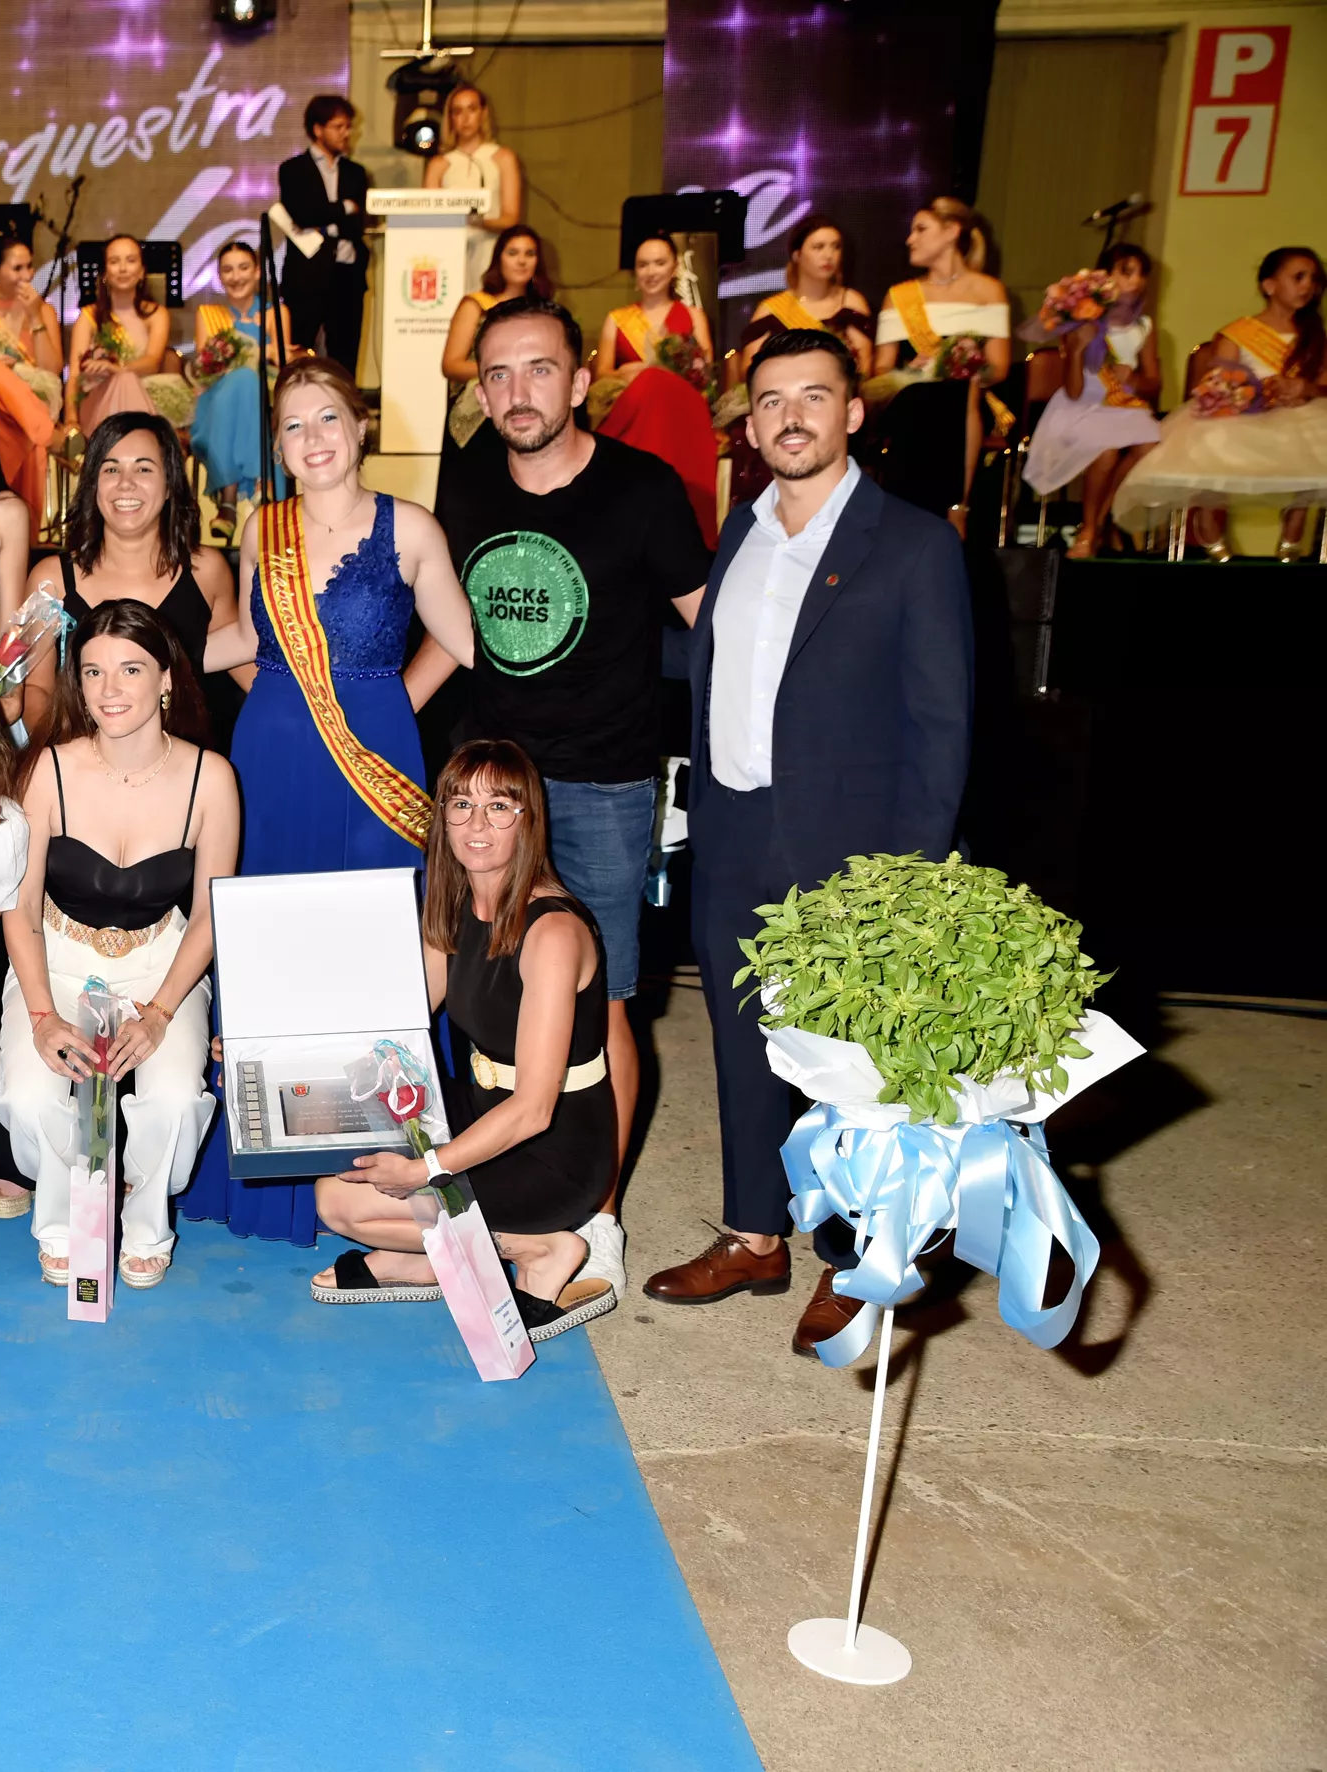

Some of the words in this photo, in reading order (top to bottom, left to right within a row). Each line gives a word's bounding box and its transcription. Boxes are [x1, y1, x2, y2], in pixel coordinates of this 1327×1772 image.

[1210, 33, 1275, 98] P
[1214, 117, 1251, 183] 7
[519, 535, 558, 555] SEARCH
[558, 554, 575, 575] THE
[571, 576, 584, 614] WORLD
[484, 603, 549, 623] JONES
